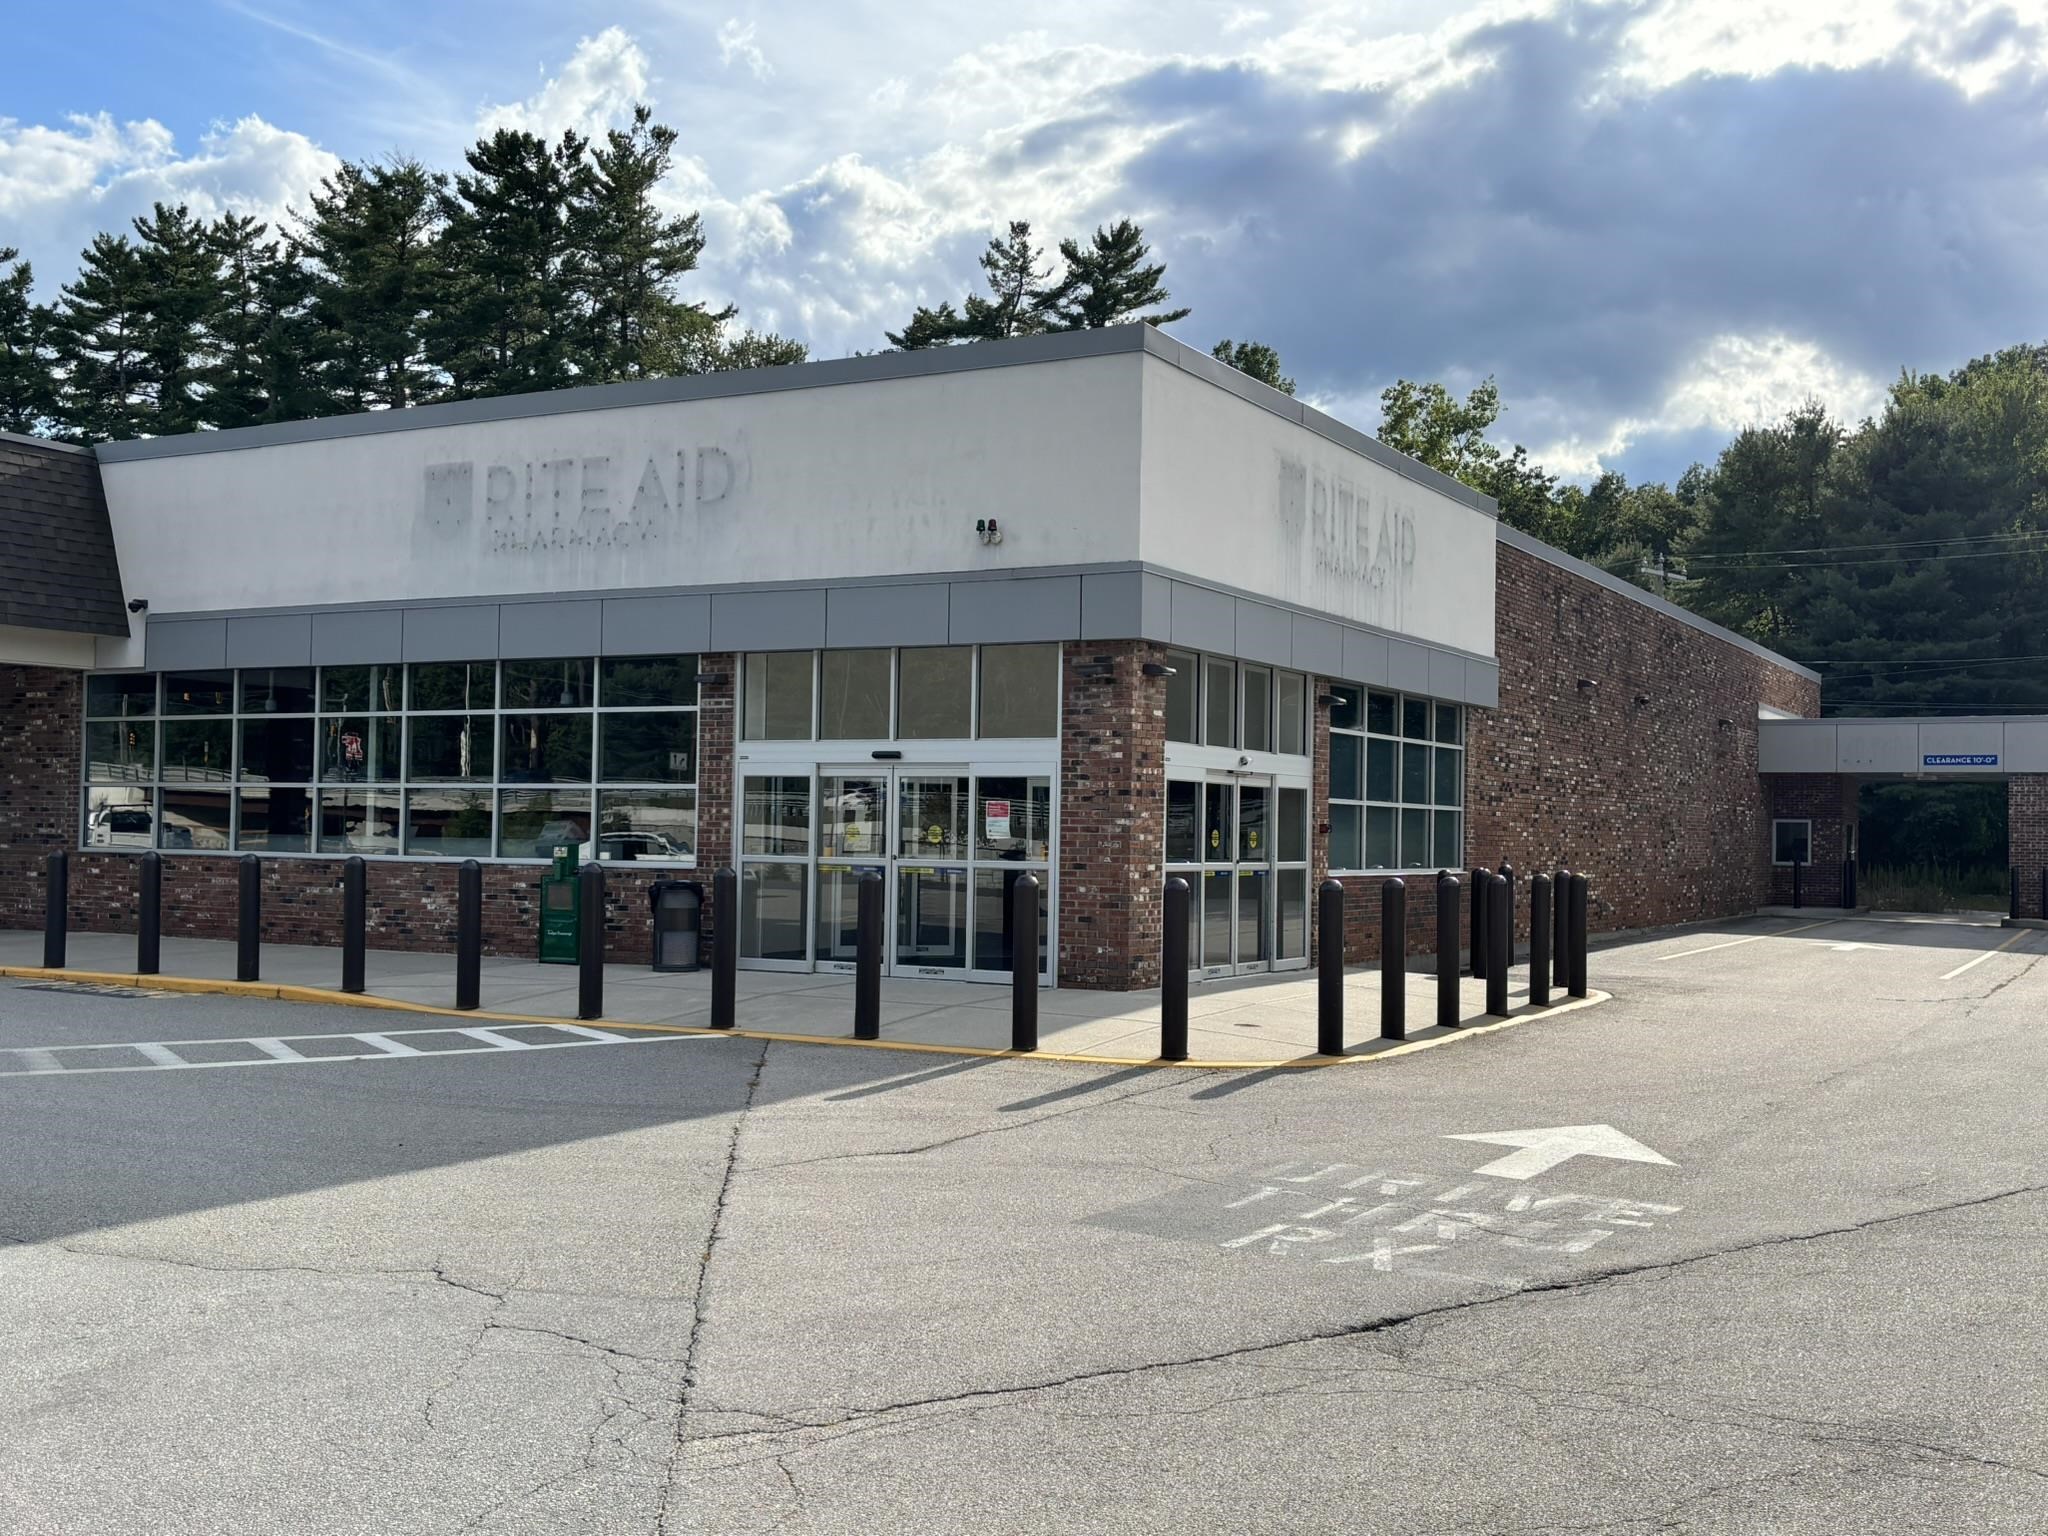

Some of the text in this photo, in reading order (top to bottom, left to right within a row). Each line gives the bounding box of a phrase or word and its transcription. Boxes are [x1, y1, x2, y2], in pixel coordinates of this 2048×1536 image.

[487, 446, 737, 520] RITE AID
[1312, 477, 1416, 566] RITE AID
